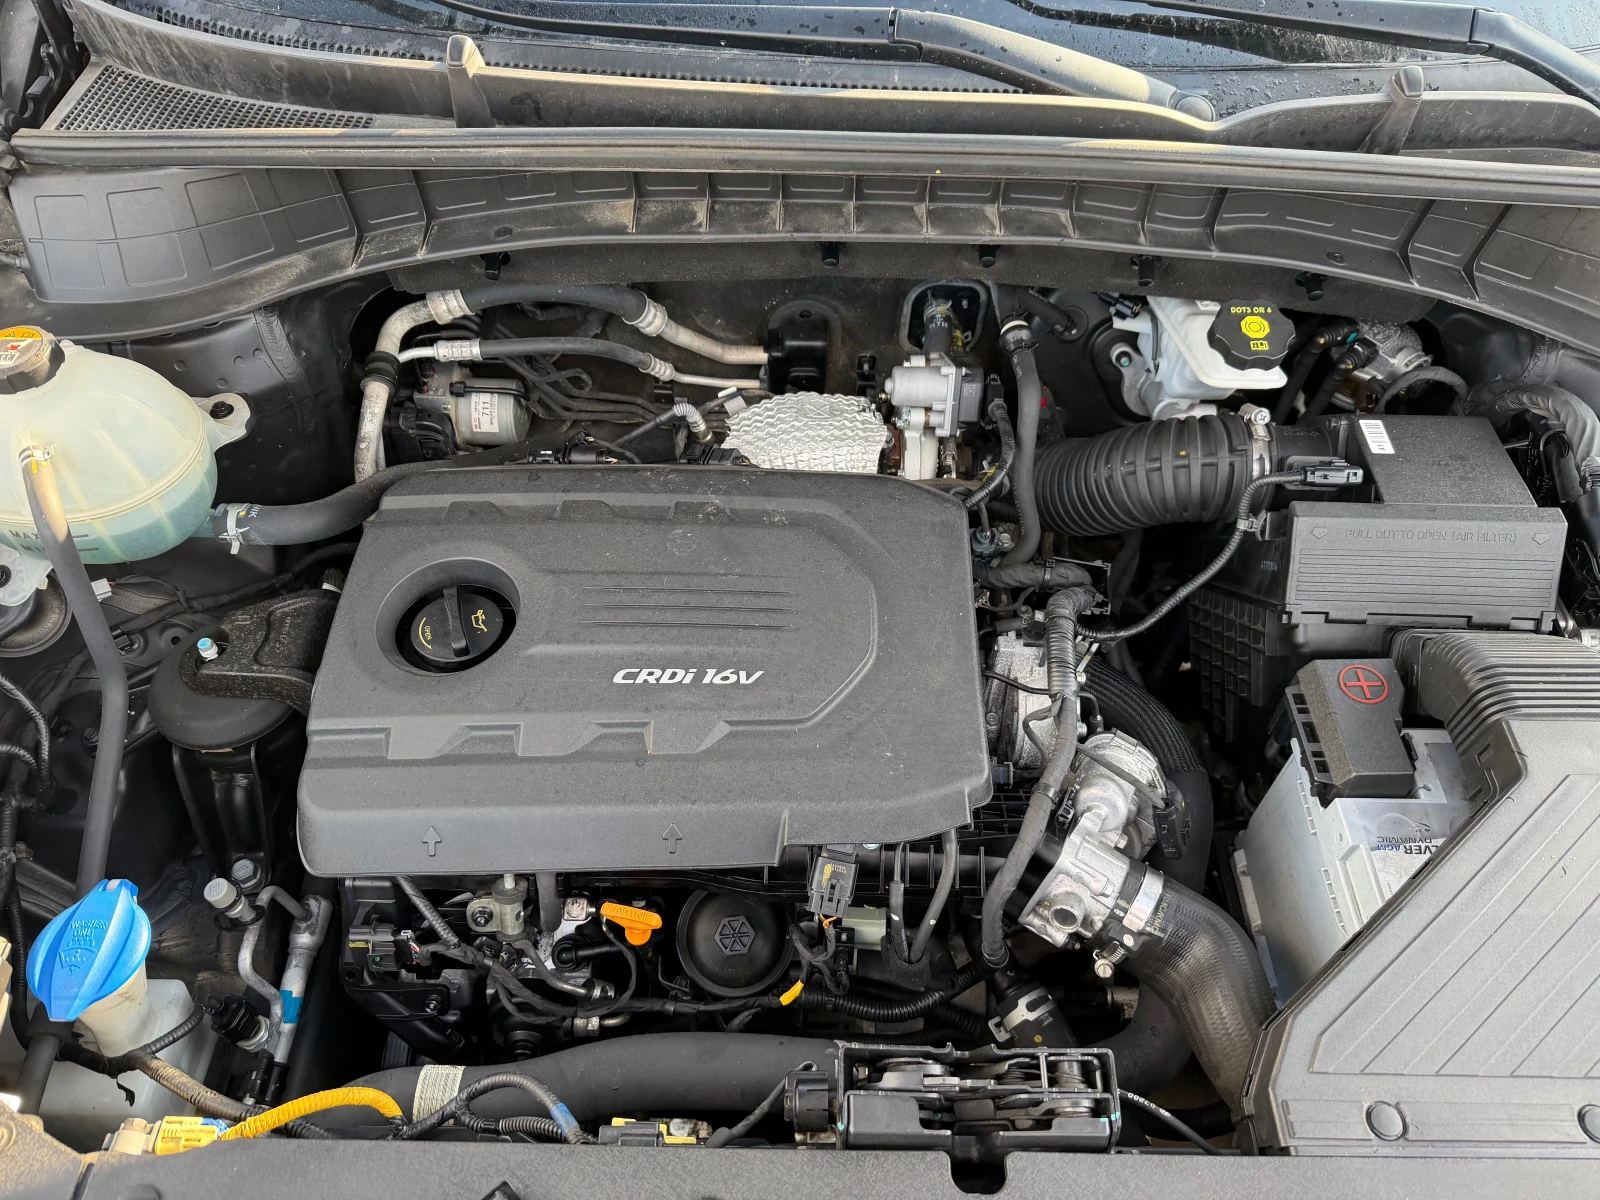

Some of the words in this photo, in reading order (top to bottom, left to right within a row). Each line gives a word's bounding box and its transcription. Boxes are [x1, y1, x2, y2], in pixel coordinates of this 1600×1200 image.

[481, 401, 490, 417] 711
[1345, 528, 1373, 539] PULL
[1375, 529, 1398, 539] OUT
[1400, 530, 1414, 540] TO
[1417, 530, 1447, 541] OPEN
[1451, 531, 1475, 542] (AIR
[1477, 532, 1517, 543] FILTER)
[20, 544, 46, 553] MI
[612, 668, 698, 684] CRDi
[701, 668, 765, 684] 16V
[1377, 836, 1432, 844] DYNAMIC
[607, 904, 652, 923] ENGINE
